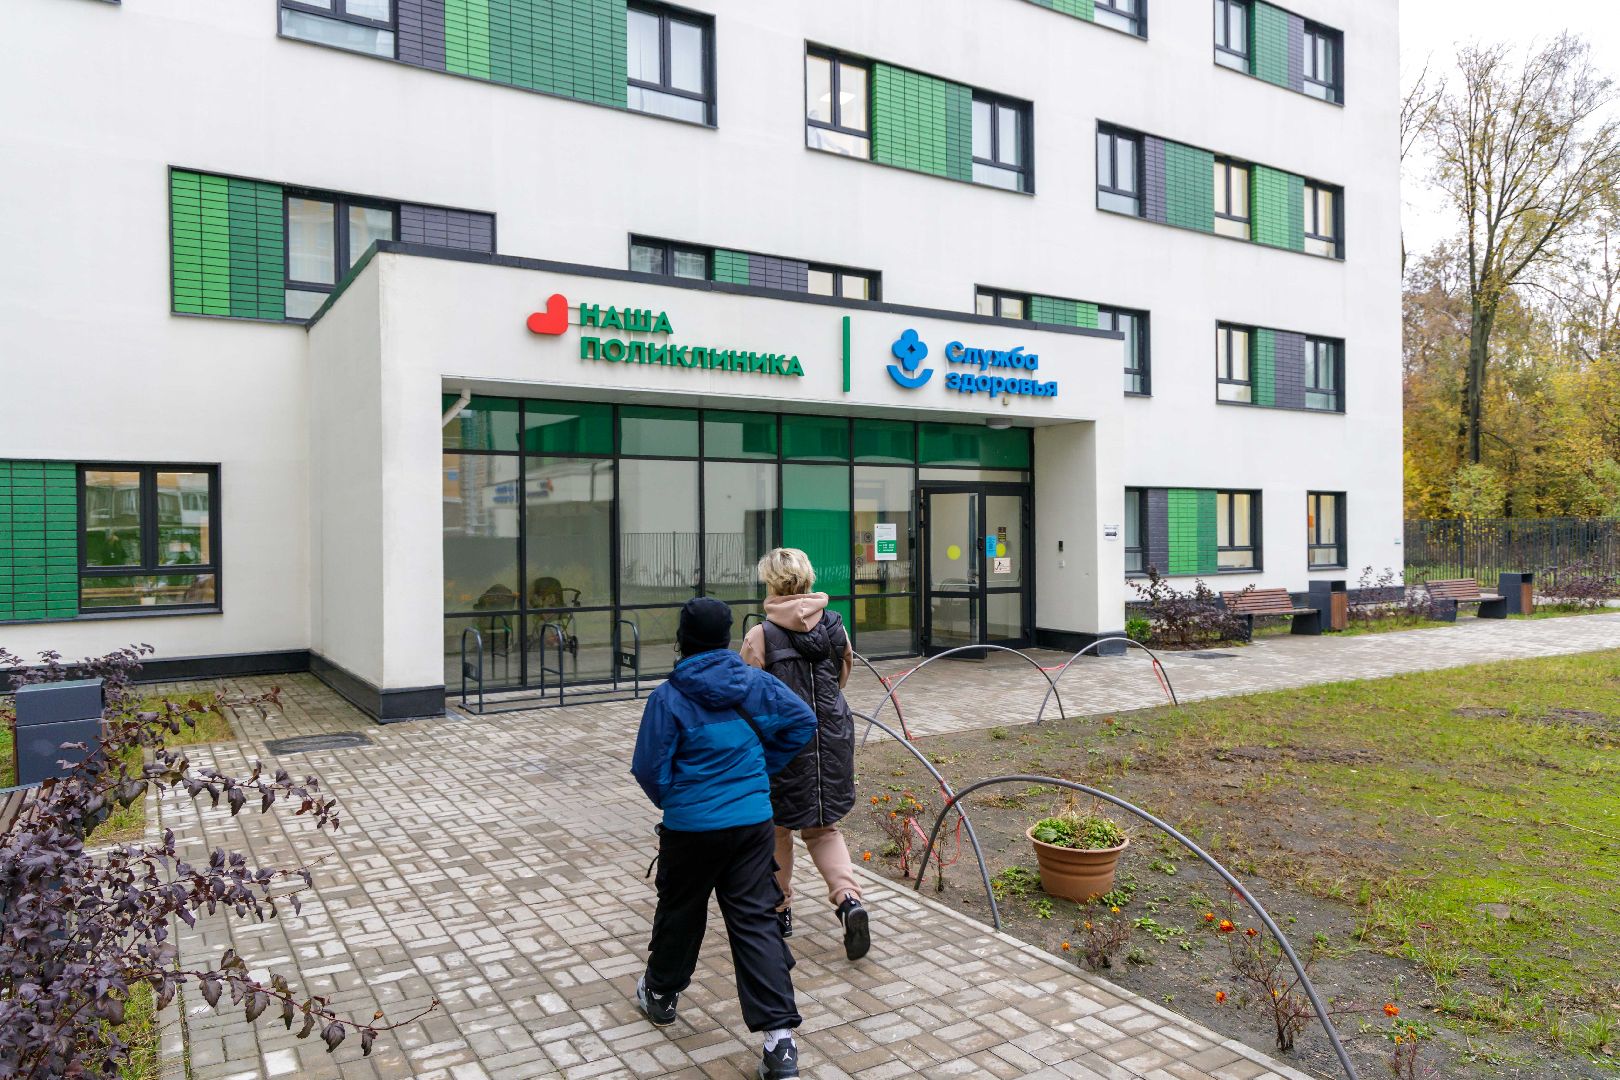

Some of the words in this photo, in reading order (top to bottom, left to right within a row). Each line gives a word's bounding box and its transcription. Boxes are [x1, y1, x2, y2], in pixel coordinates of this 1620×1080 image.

[580, 303, 673, 334] НАША
[580, 336, 805, 376] ПОЛИКЛИНИКА
[945, 341, 1039, 371] Служба
[945, 372, 1058, 398] здоровья
